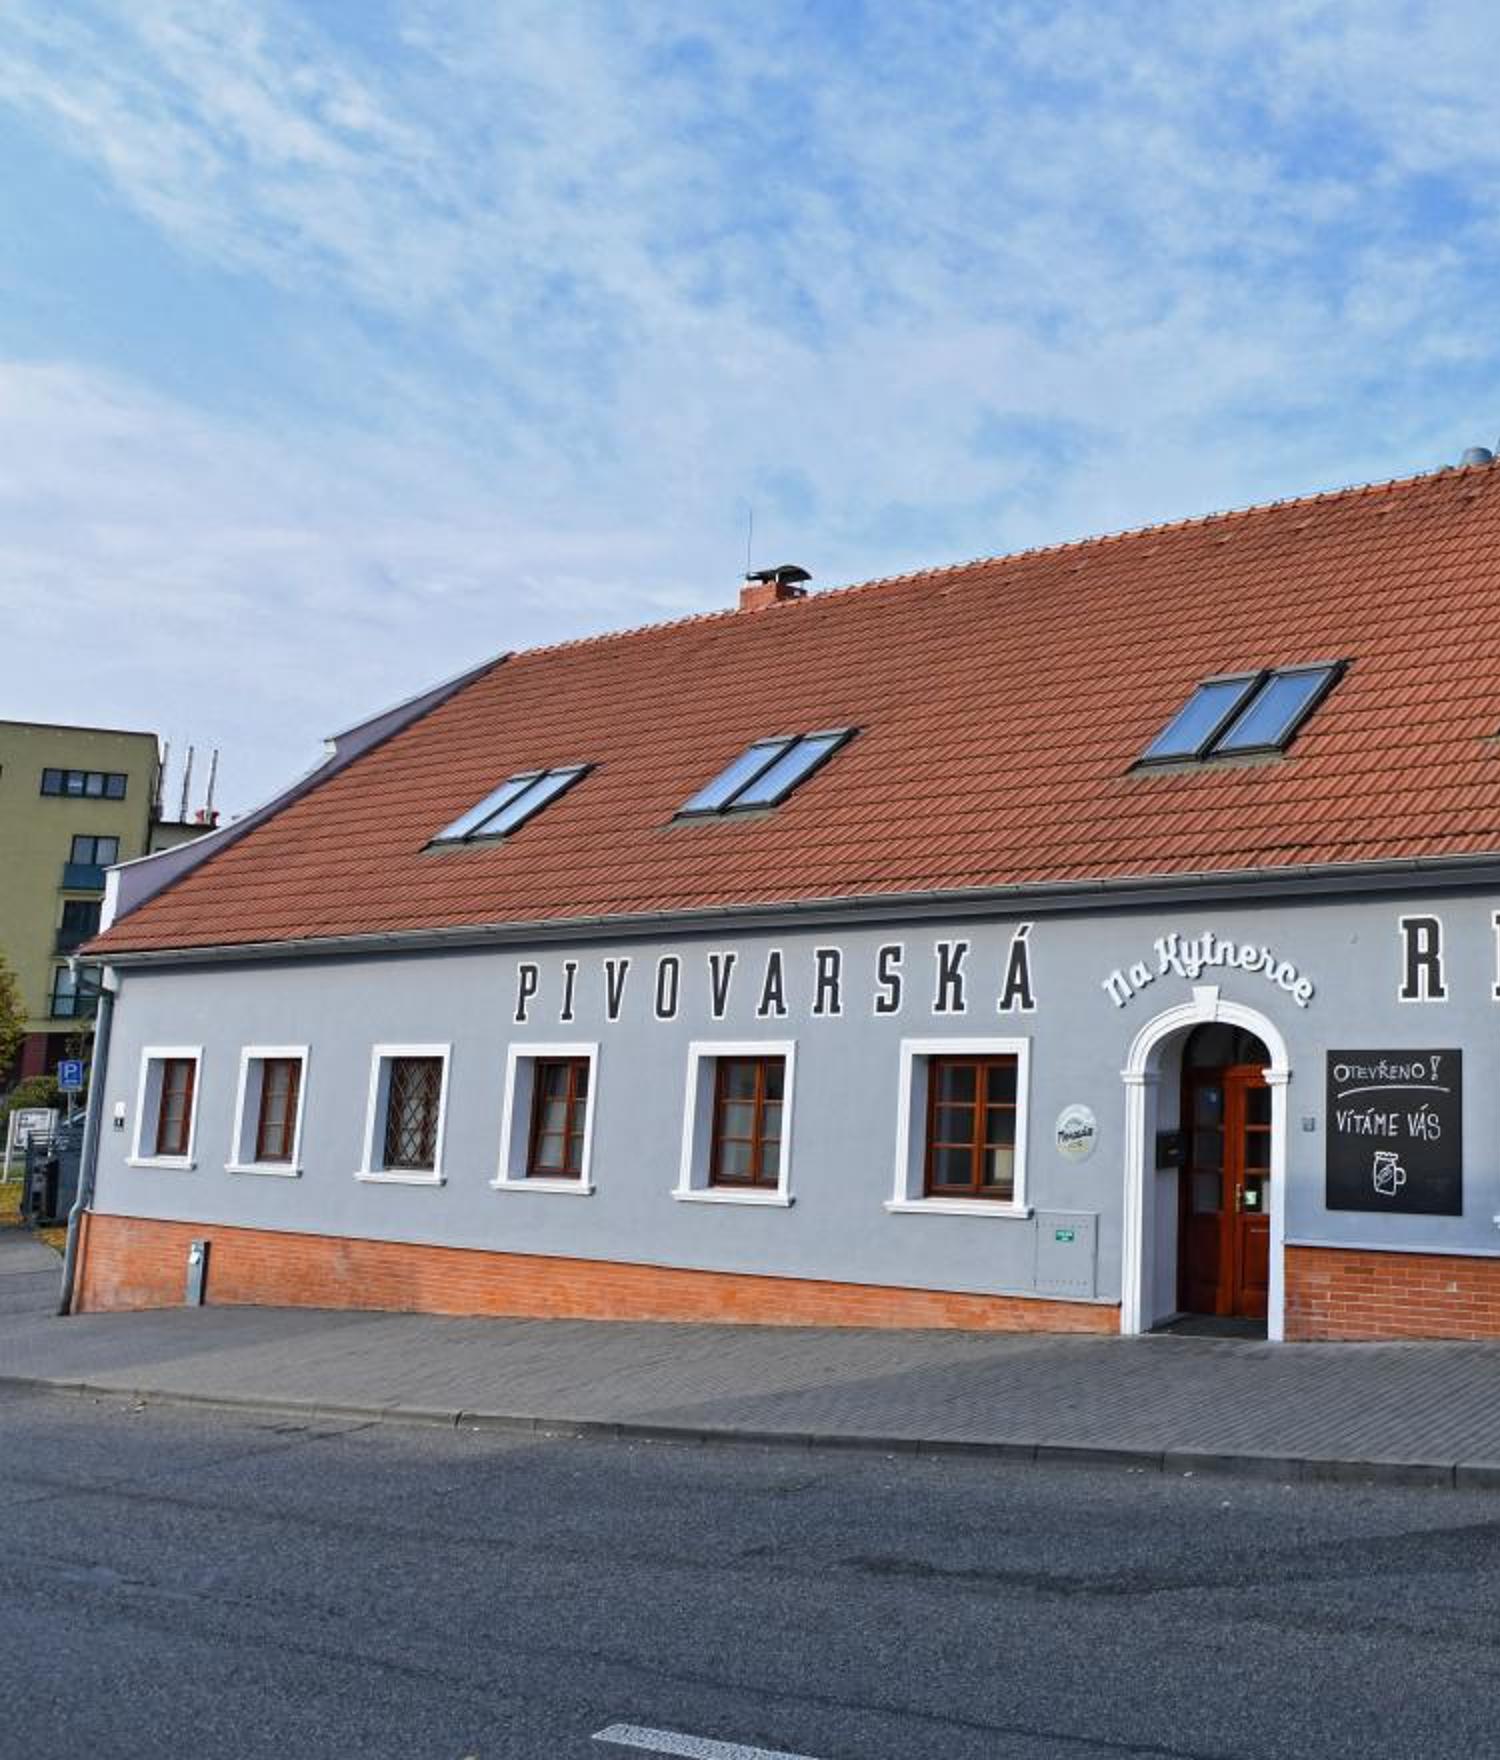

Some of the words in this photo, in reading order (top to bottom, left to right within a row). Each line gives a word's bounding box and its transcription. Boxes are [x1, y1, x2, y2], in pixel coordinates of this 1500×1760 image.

[514, 923, 1036, 1024] PIVOVARSKÁ
[1101, 960, 1155, 1008] Na
[1154, 931, 1316, 1008] Kytnerce
[64, 1063, 78, 1078] P
[1336, 1107, 1400, 1137] VÍTÁME
[1407, 1103, 1442, 1141] VÁS
